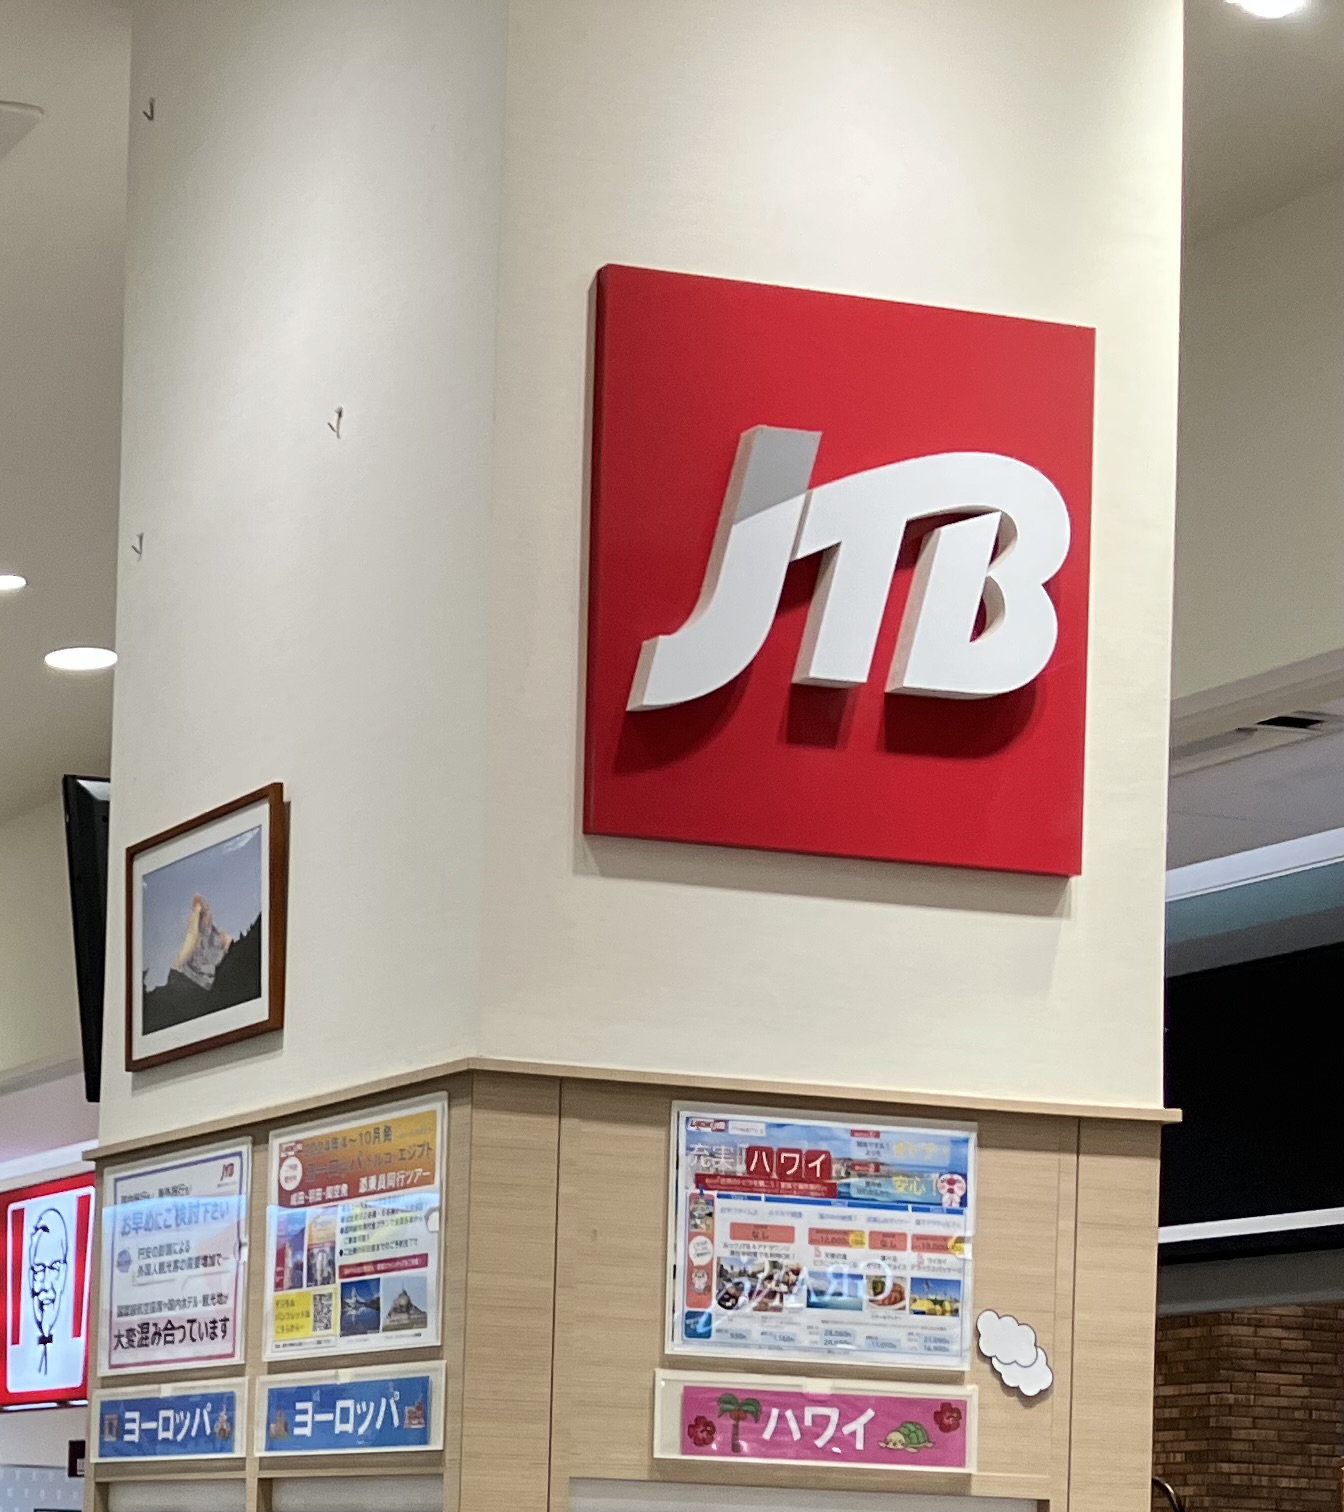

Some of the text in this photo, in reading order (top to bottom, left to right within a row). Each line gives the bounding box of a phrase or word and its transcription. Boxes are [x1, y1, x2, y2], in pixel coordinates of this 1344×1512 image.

[626, 425, 1071, 712] JTB
[123, 1402, 211, 1442] ヨーロッパ
[293, 1391, 400, 1438] ヨーロッパ
[762, 1407, 876, 1450] ハワイ
